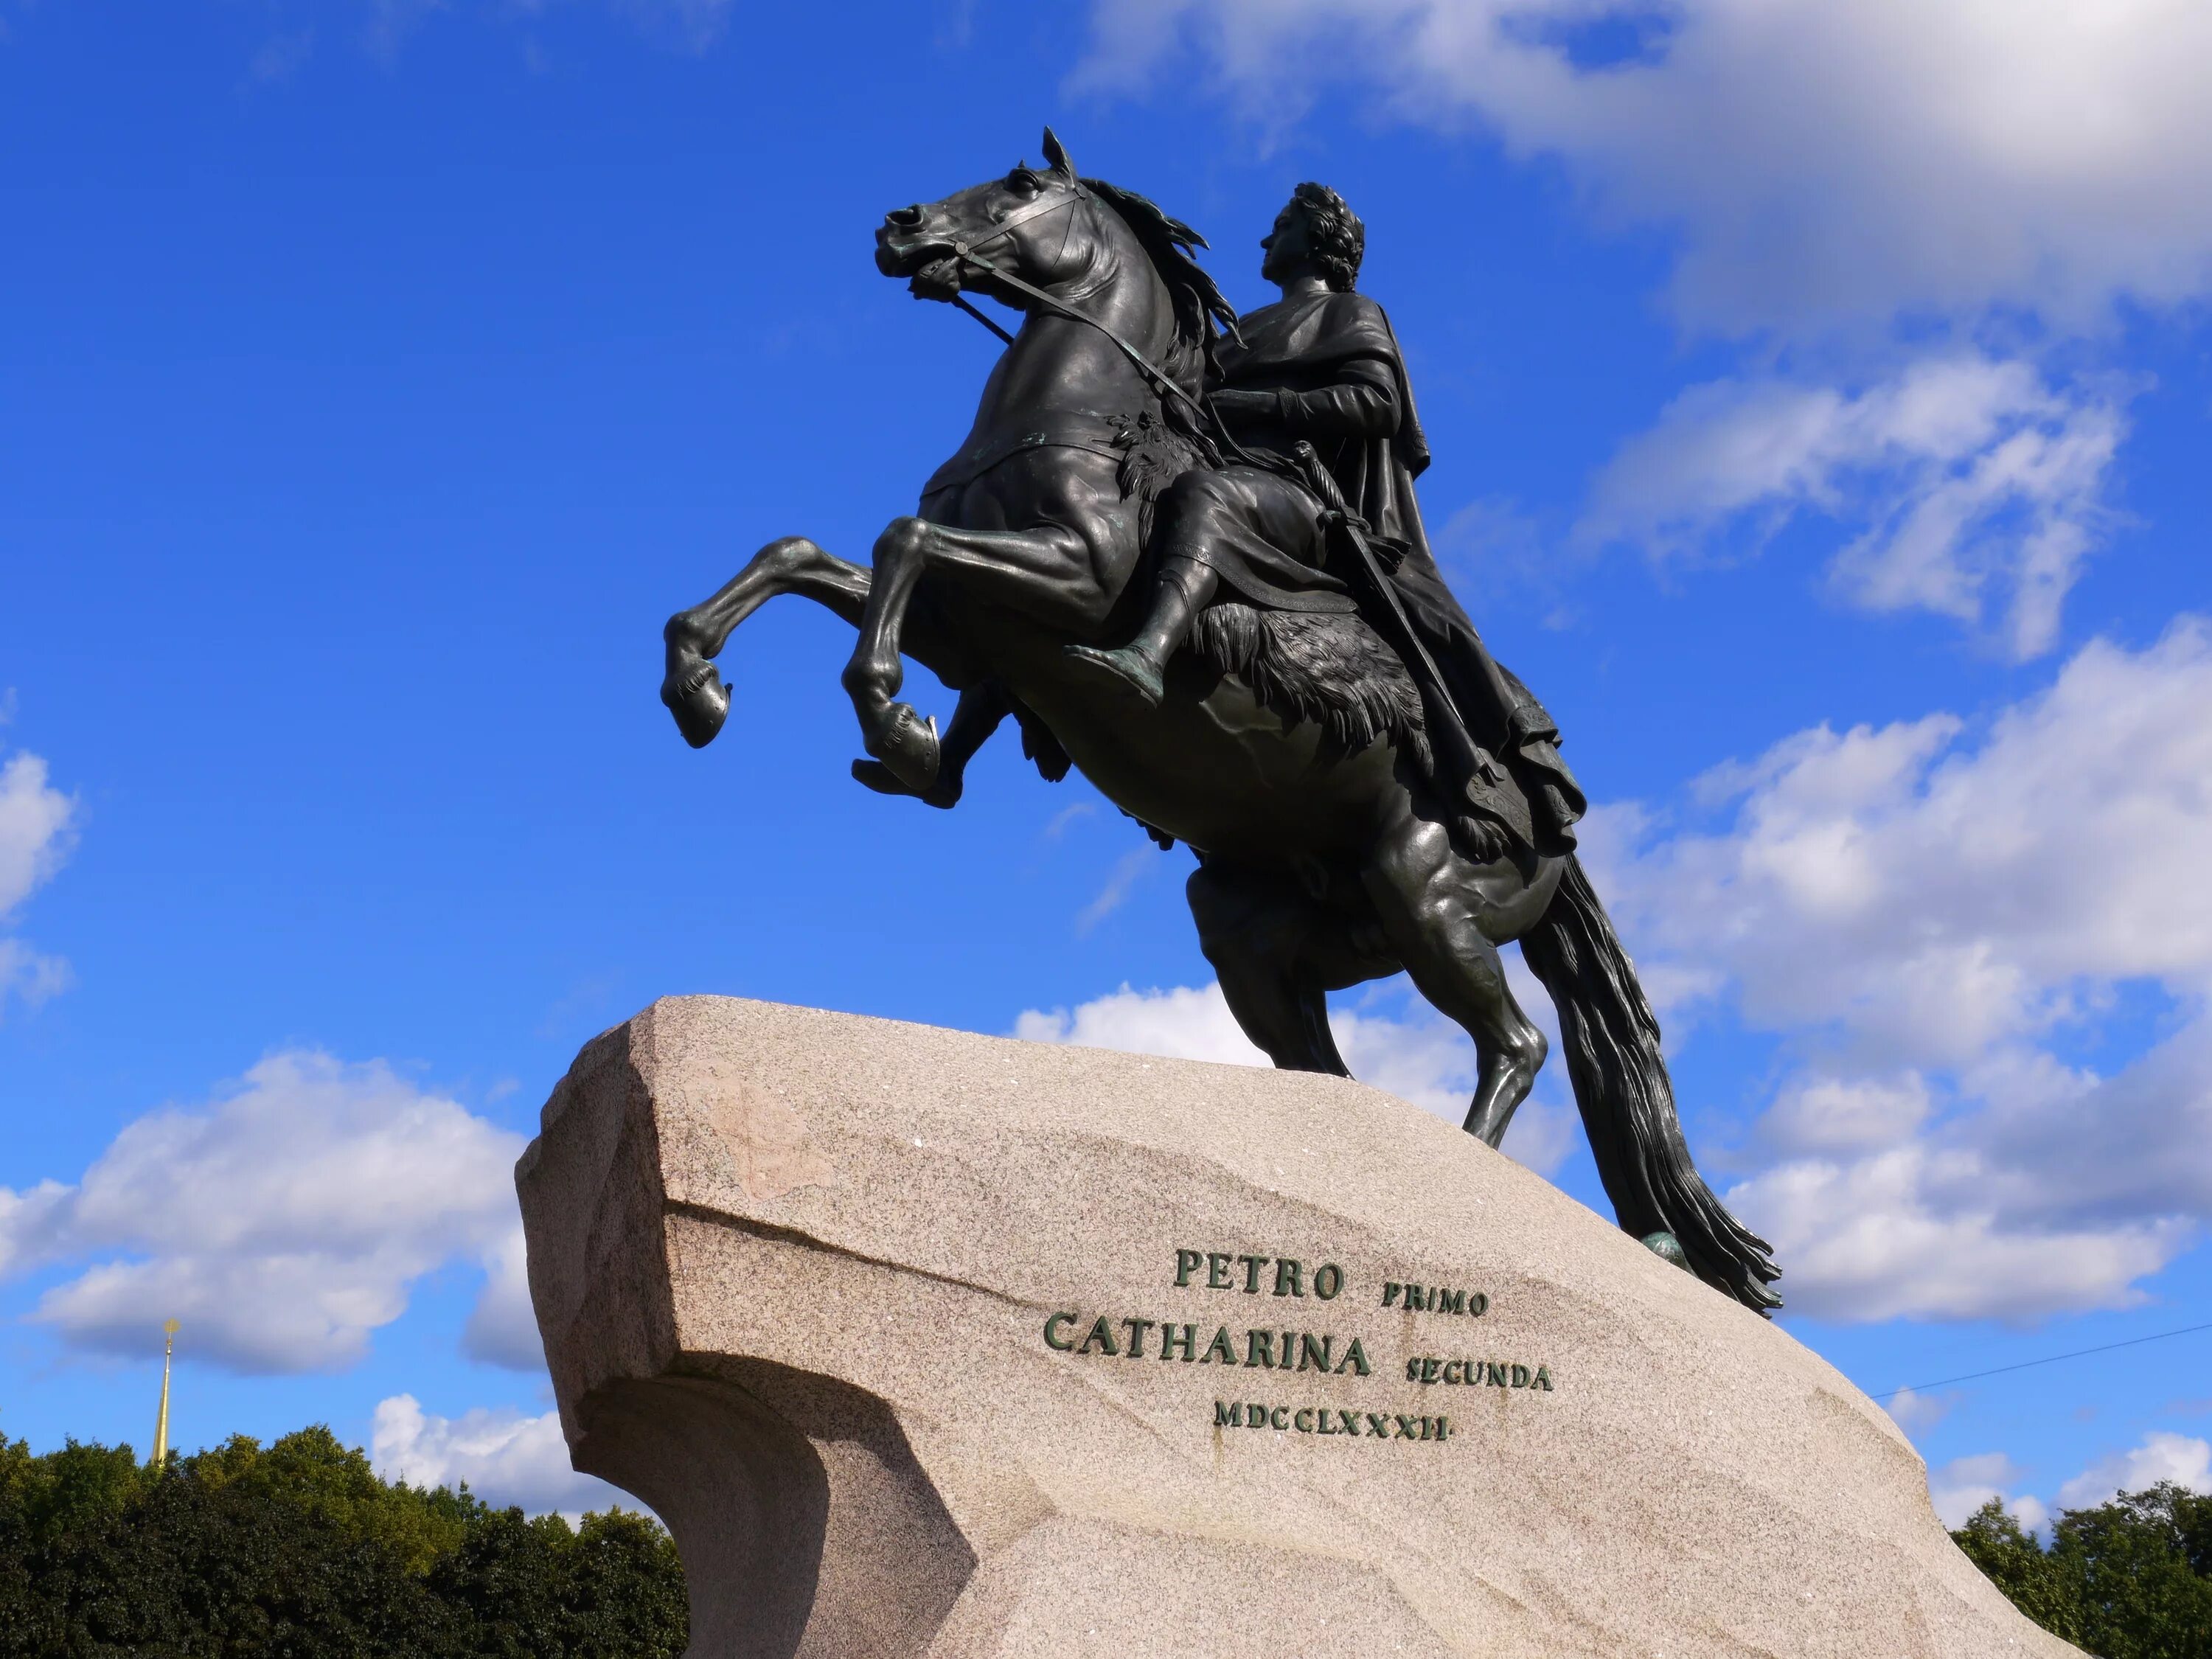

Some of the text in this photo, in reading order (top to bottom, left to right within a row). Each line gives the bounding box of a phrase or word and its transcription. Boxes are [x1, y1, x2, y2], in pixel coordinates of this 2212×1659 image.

[1173, 1248, 1489, 1317] PETRO PRIMO
[1043, 1312, 1554, 1391] CATHARINA SECUNDA
